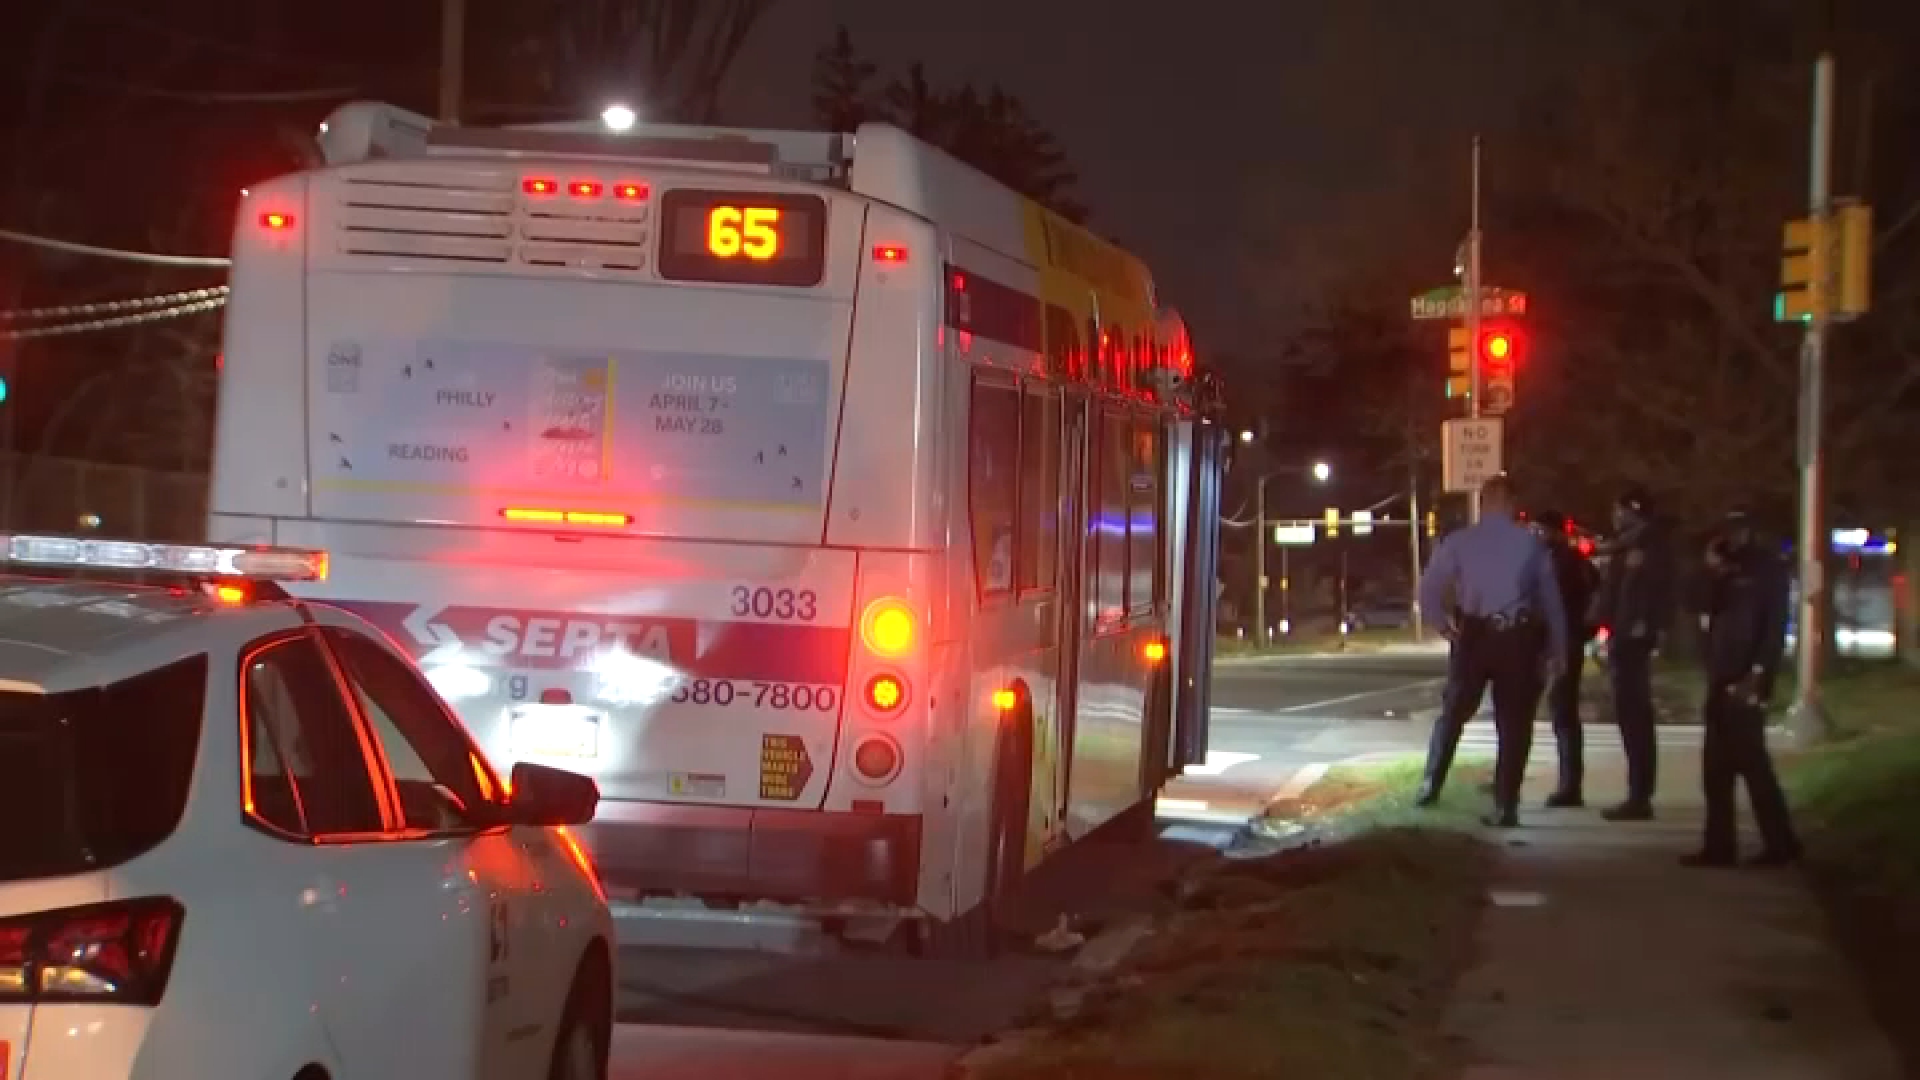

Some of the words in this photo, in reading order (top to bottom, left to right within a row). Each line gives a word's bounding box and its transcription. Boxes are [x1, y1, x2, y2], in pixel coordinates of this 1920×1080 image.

[709, 206, 779, 258] 65
[662, 372, 707, 391] JOIN
[711, 375, 737, 392] US
[436, 389, 497, 408] PHILLY
[649, 393, 700, 412] APRIL
[655, 415, 697, 433] MAY
[701, 418, 724, 434] 28
[1462, 425, 1489, 440] NO
[388, 443, 469, 463] READING
[731, 585, 817, 621] 3033
[483, 615, 671, 662] SEPTA
